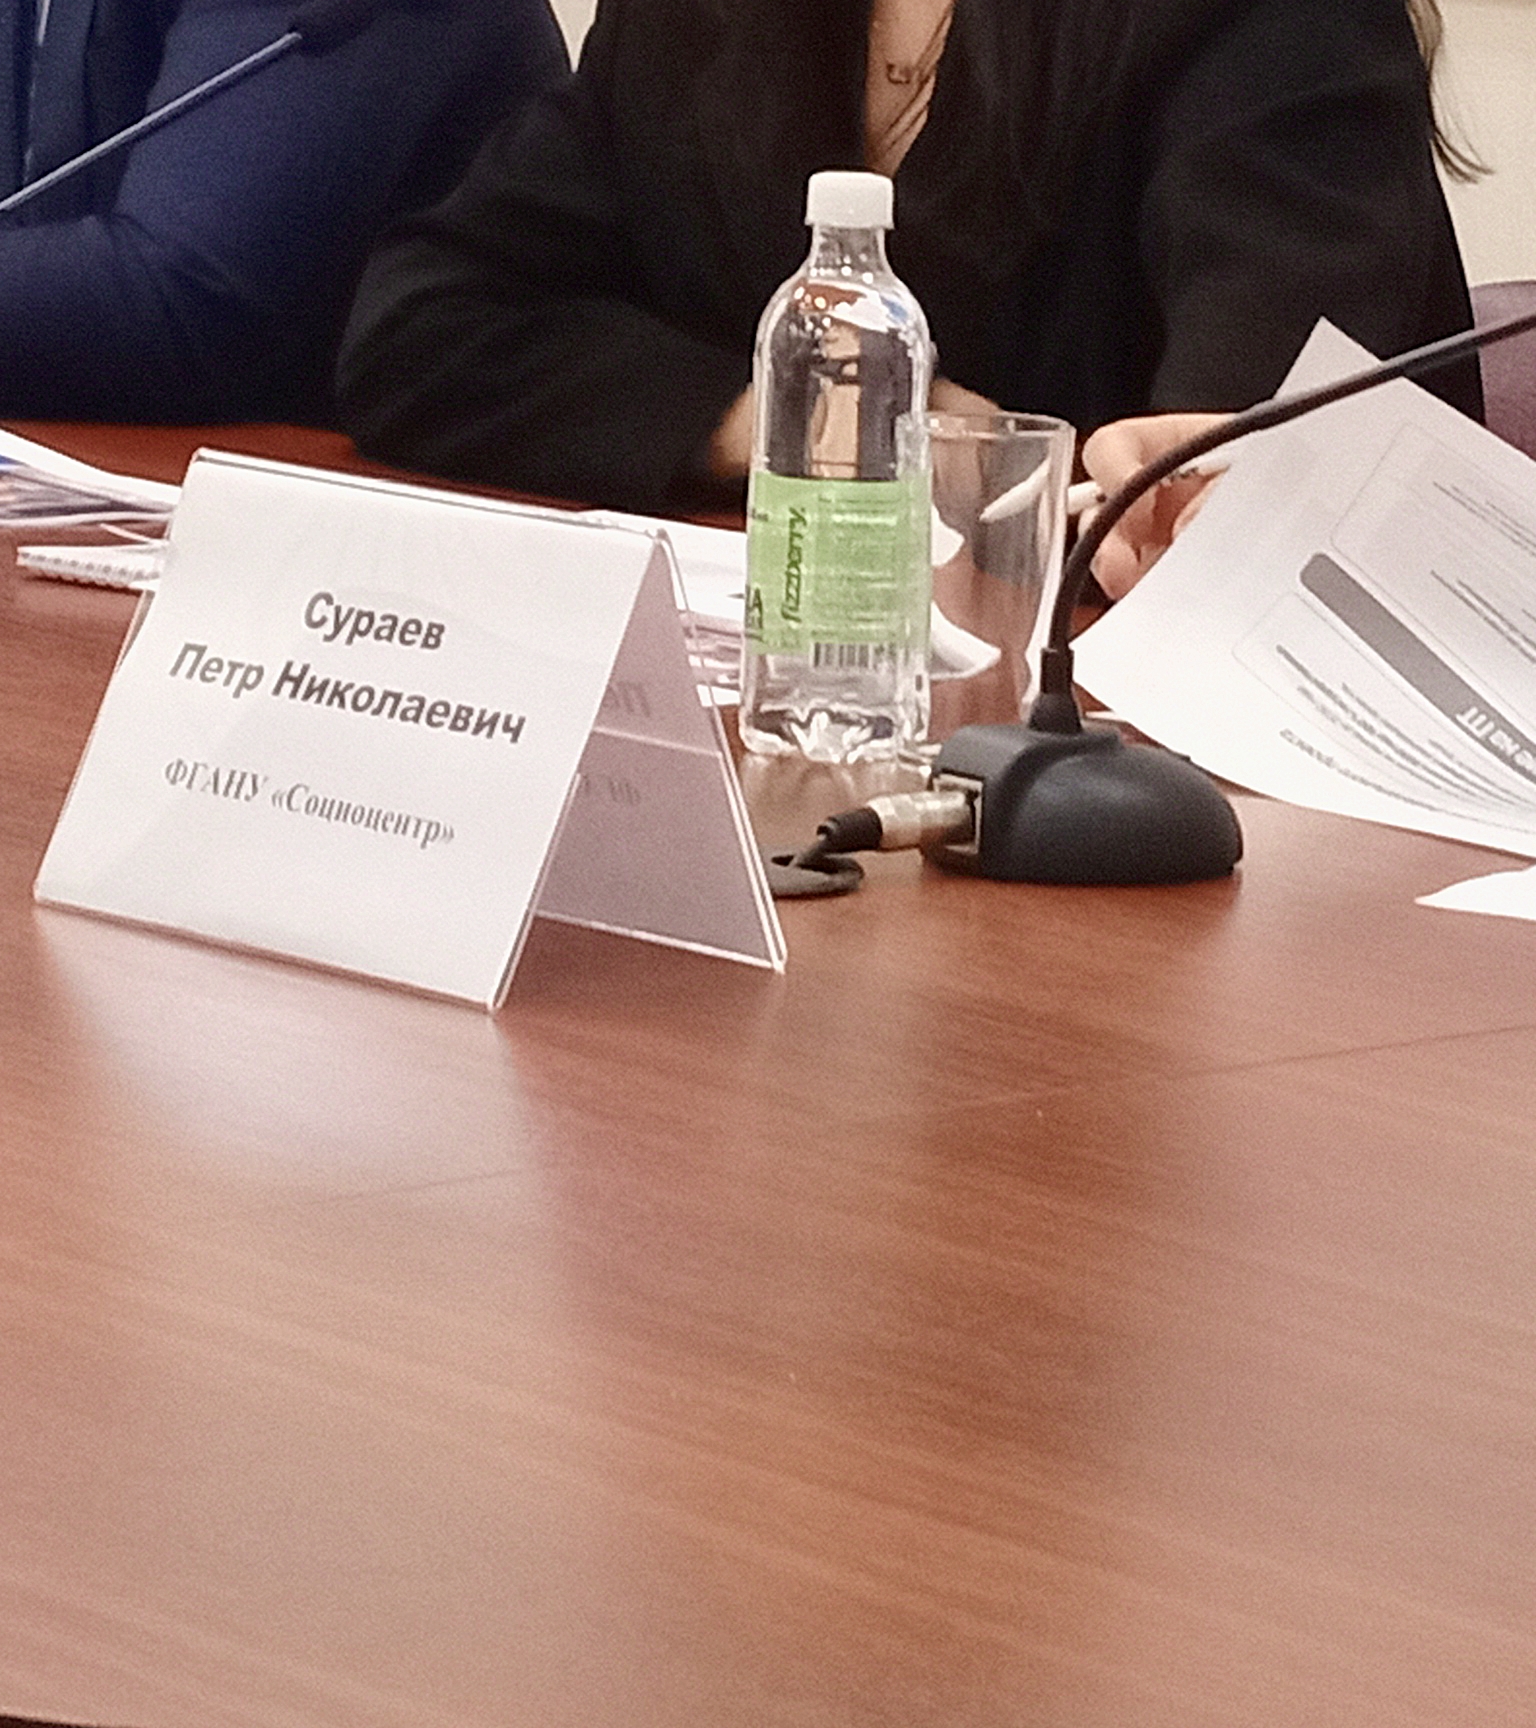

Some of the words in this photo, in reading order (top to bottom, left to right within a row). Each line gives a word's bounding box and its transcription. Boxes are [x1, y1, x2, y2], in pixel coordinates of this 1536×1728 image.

[304, 591, 446, 651] Сураев
[168, 642, 265, 699] Петр
[271, 660, 527, 744] Николаевич
[164, 758, 269, 804] ФГАНУ
